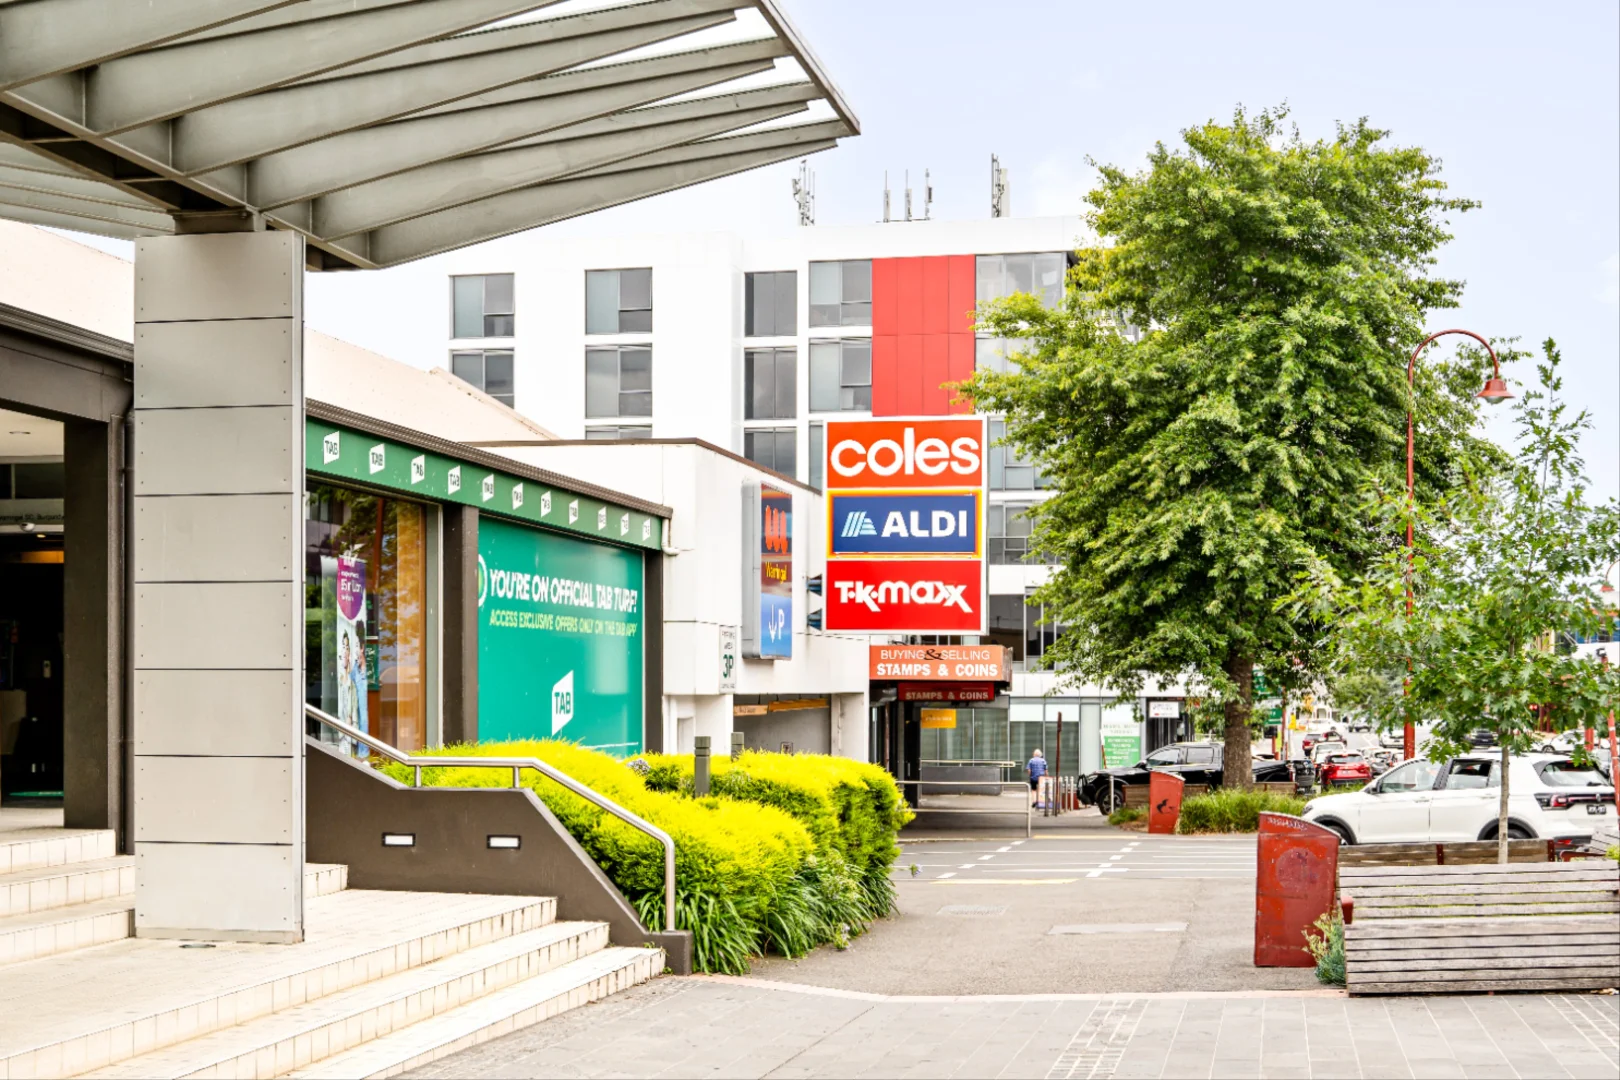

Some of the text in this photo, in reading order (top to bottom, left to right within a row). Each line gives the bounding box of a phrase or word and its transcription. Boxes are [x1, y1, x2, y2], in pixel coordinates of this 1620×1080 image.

[831, 427, 980, 477] coles
[881, 510, 967, 538] ALDI
[490, 569, 530, 601] YOU'RE
[531, 575, 549, 603] ON
[551, 577, 594, 608] OFFICIAL
[596, 584, 612, 609] TAB
[489, 609, 518, 627] ACCESS
[519, 612, 553, 630] EXCLUSIVE
[555, 615, 578, 632] OFFERS
[580, 617, 594, 634] ONLY
[595, 619, 604, 634] ON
[615, 621, 625, 636] TAB
[723, 653, 734, 678] 3P
[880, 648, 990, 660] BUYING & SELLING
[877, 663, 998, 676] STAMPS & COINS
[554, 691, 571, 715] TAB
[905, 691, 989, 700] STAMPS & COINS
